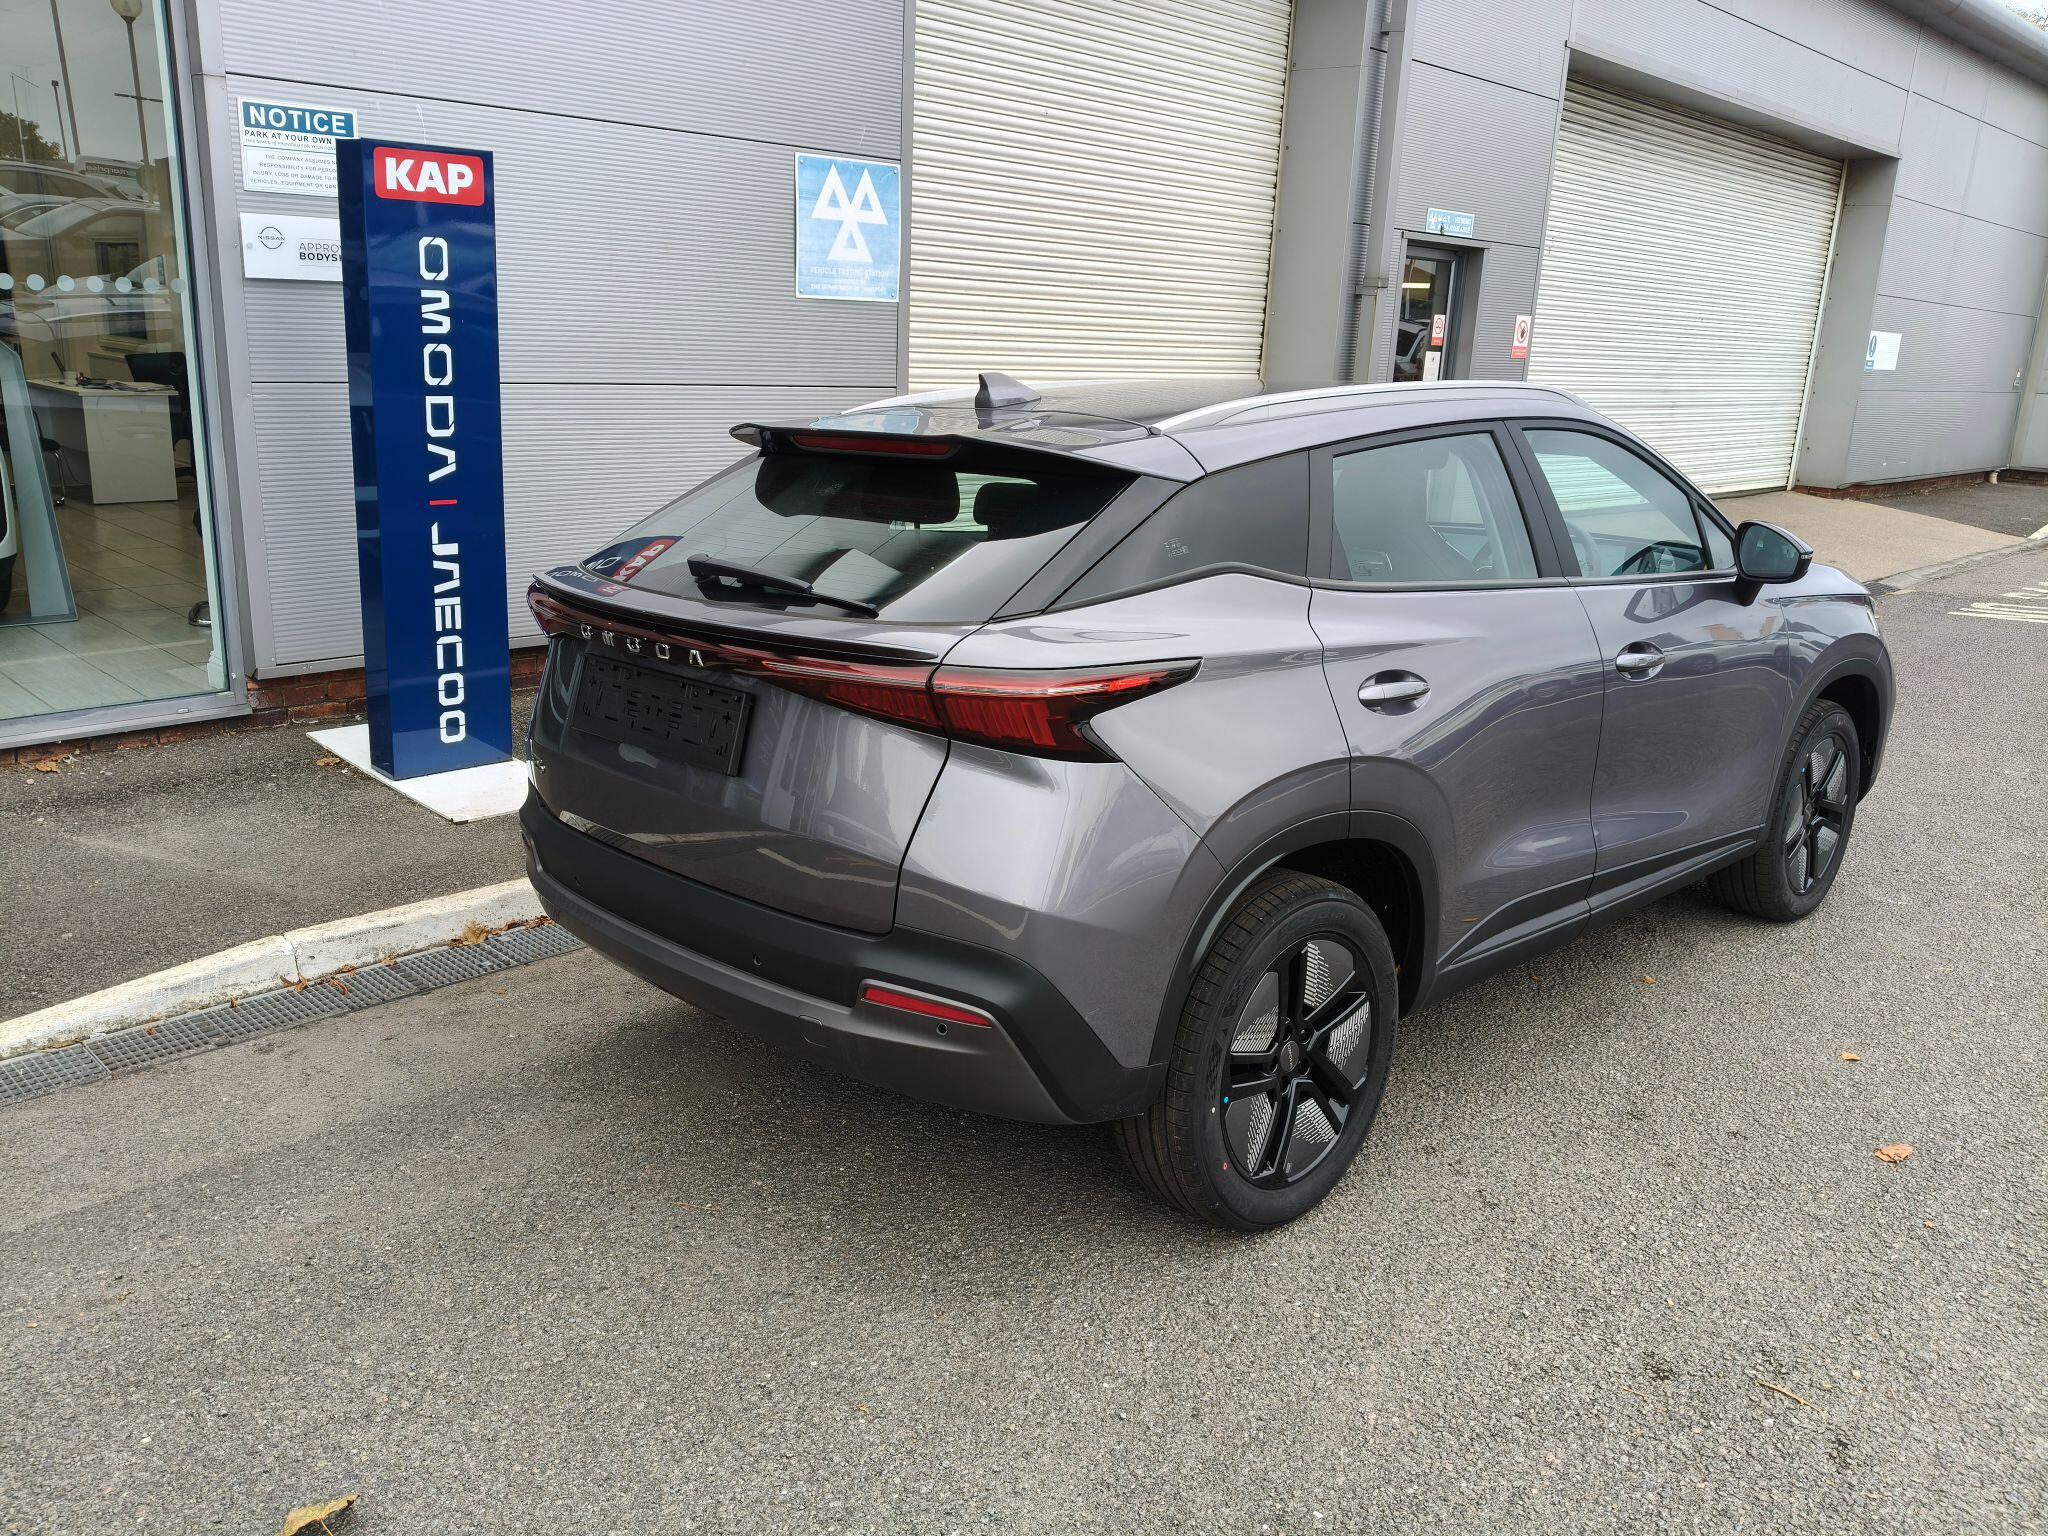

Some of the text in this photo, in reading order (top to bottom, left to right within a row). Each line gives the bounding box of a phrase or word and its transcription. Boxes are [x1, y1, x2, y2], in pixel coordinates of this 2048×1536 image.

[249, 104, 347, 134] NOTICE
[244, 129, 332, 145] PARK AT YOUR OWN
[259, 162, 304, 170] RESPONSIBILITY
[385, 156, 474, 195] KAP
[298, 242, 342, 253] APPRO
[418, 236, 467, 744] OMODA JAECOO
